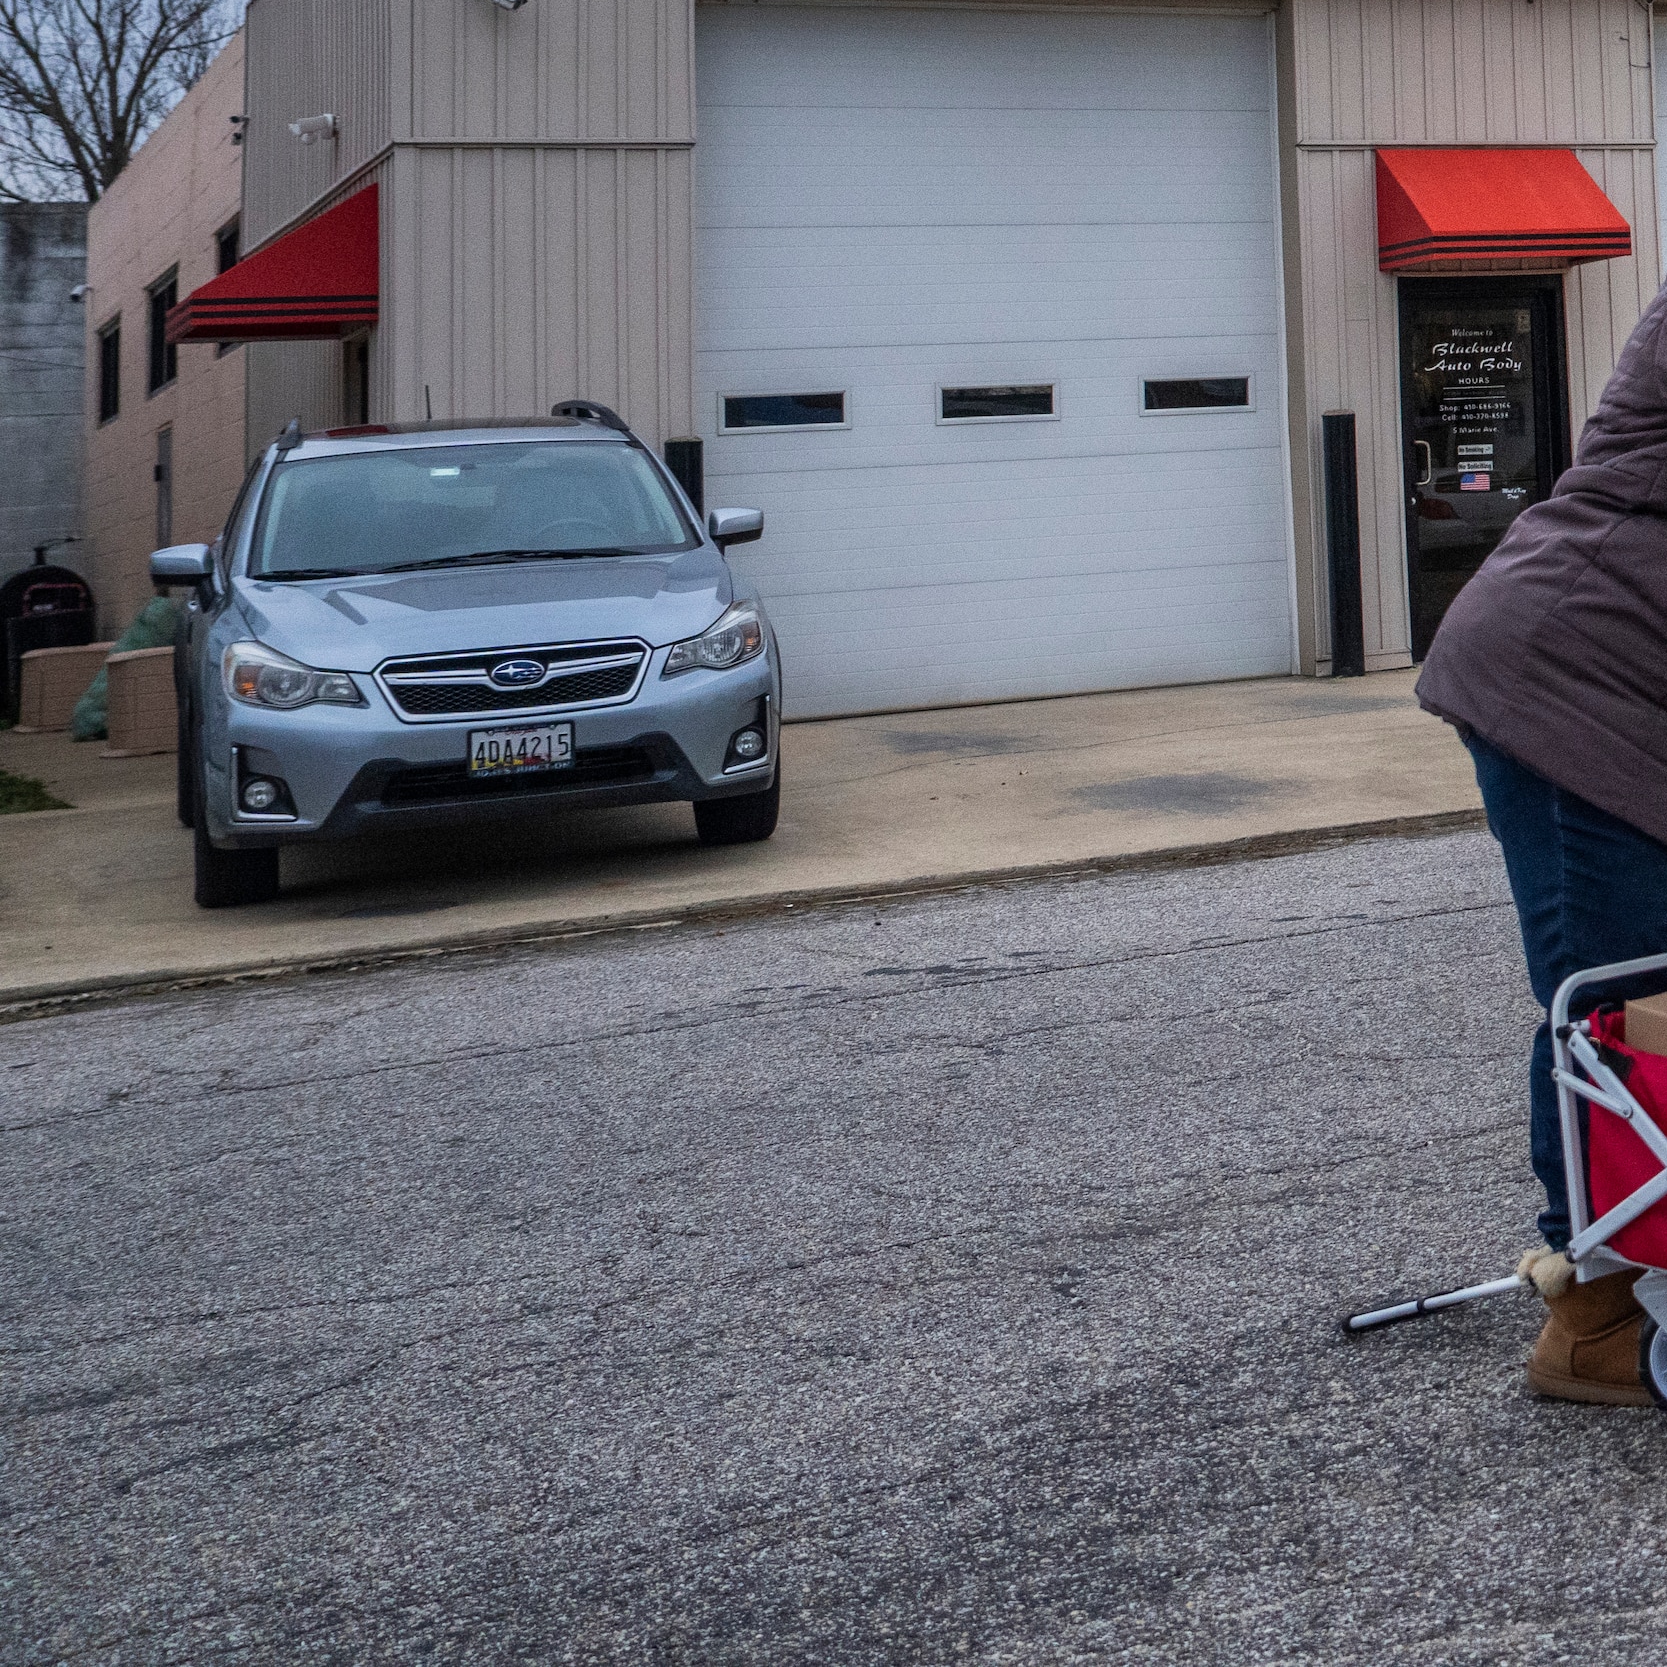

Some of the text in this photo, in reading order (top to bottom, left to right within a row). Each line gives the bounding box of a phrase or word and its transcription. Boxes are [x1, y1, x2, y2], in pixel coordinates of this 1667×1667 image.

[1451, 328, 1484, 337] Welcome
[1432, 341, 1513, 356] Blackwell
[1424, 357, 1522, 372] Auto Body
[1458, 377, 1490, 385] HOURS
[475, 733, 569, 768] 4DA4215
